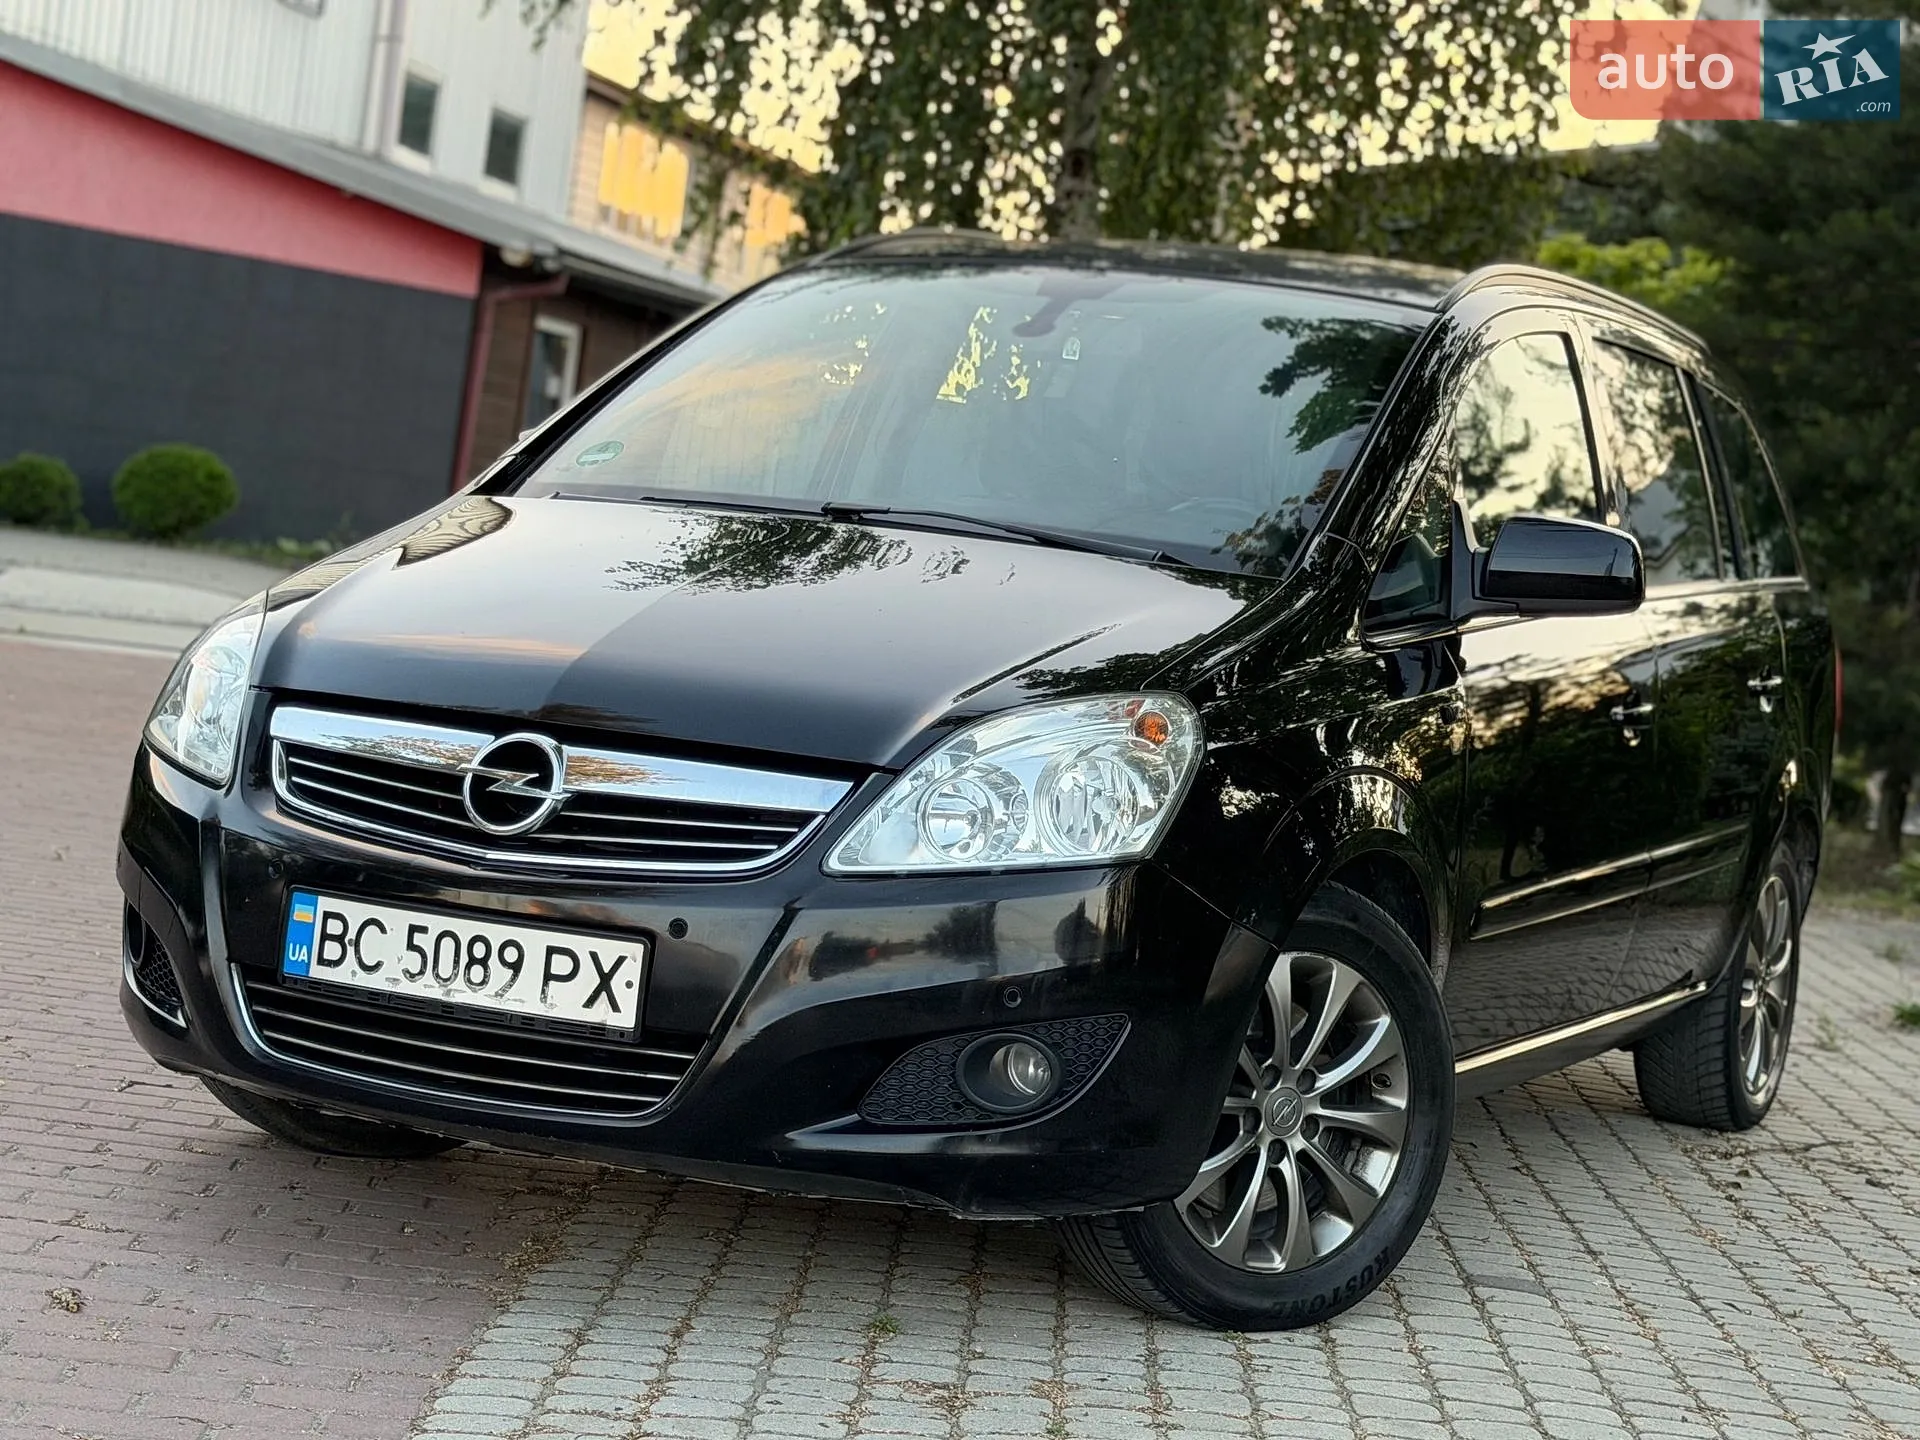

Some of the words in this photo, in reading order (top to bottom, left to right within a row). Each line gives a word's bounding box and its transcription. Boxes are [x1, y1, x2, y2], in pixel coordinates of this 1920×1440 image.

[289, 942, 309, 964] UA
[316, 910, 388, 975] BC
[401, 924, 526, 998] 5089
[540, 945, 628, 1013] PX
